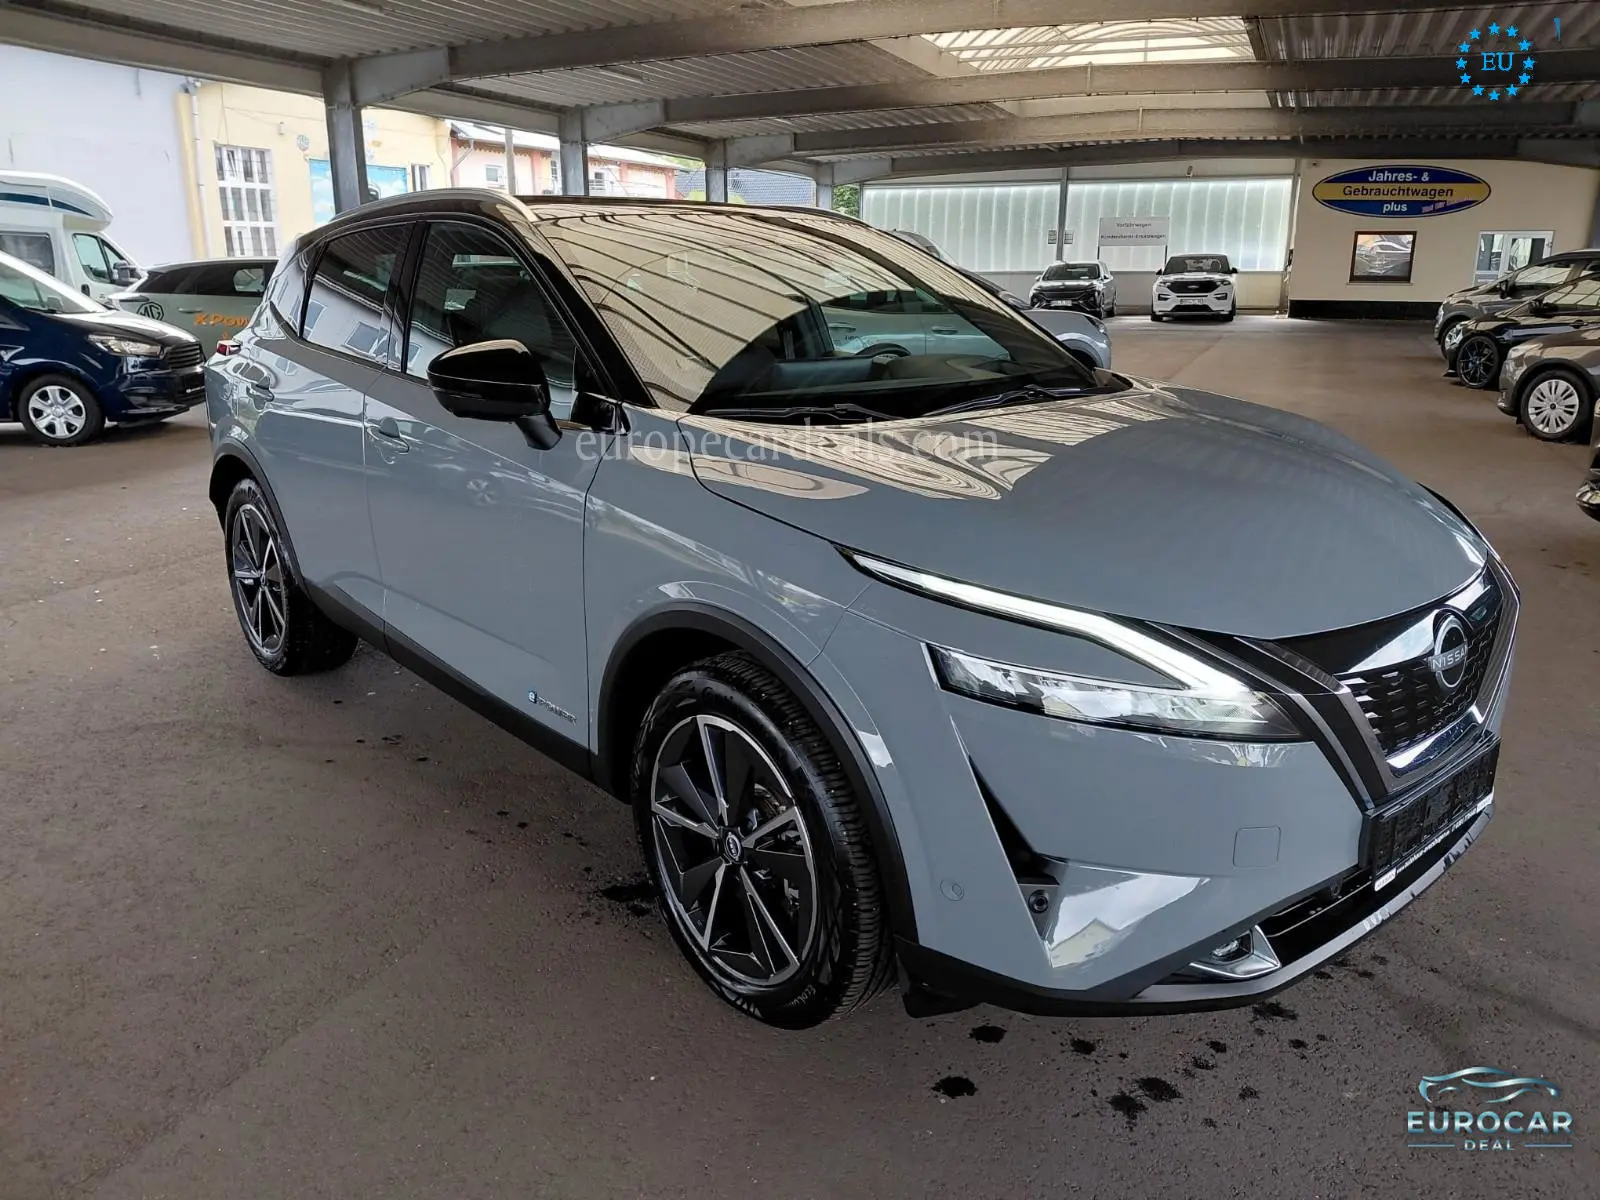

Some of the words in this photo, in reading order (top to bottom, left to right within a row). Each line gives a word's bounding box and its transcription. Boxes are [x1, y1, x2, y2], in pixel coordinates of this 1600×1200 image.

[1368, 170, 1418, 182] Jahres-
[1421, 172, 1430, 182] &
[1343, 186, 1454, 199] Gebrauchtwagen
[1383, 202, 1408, 213] plus
[1432, 647, 1467, 670] NISSA
